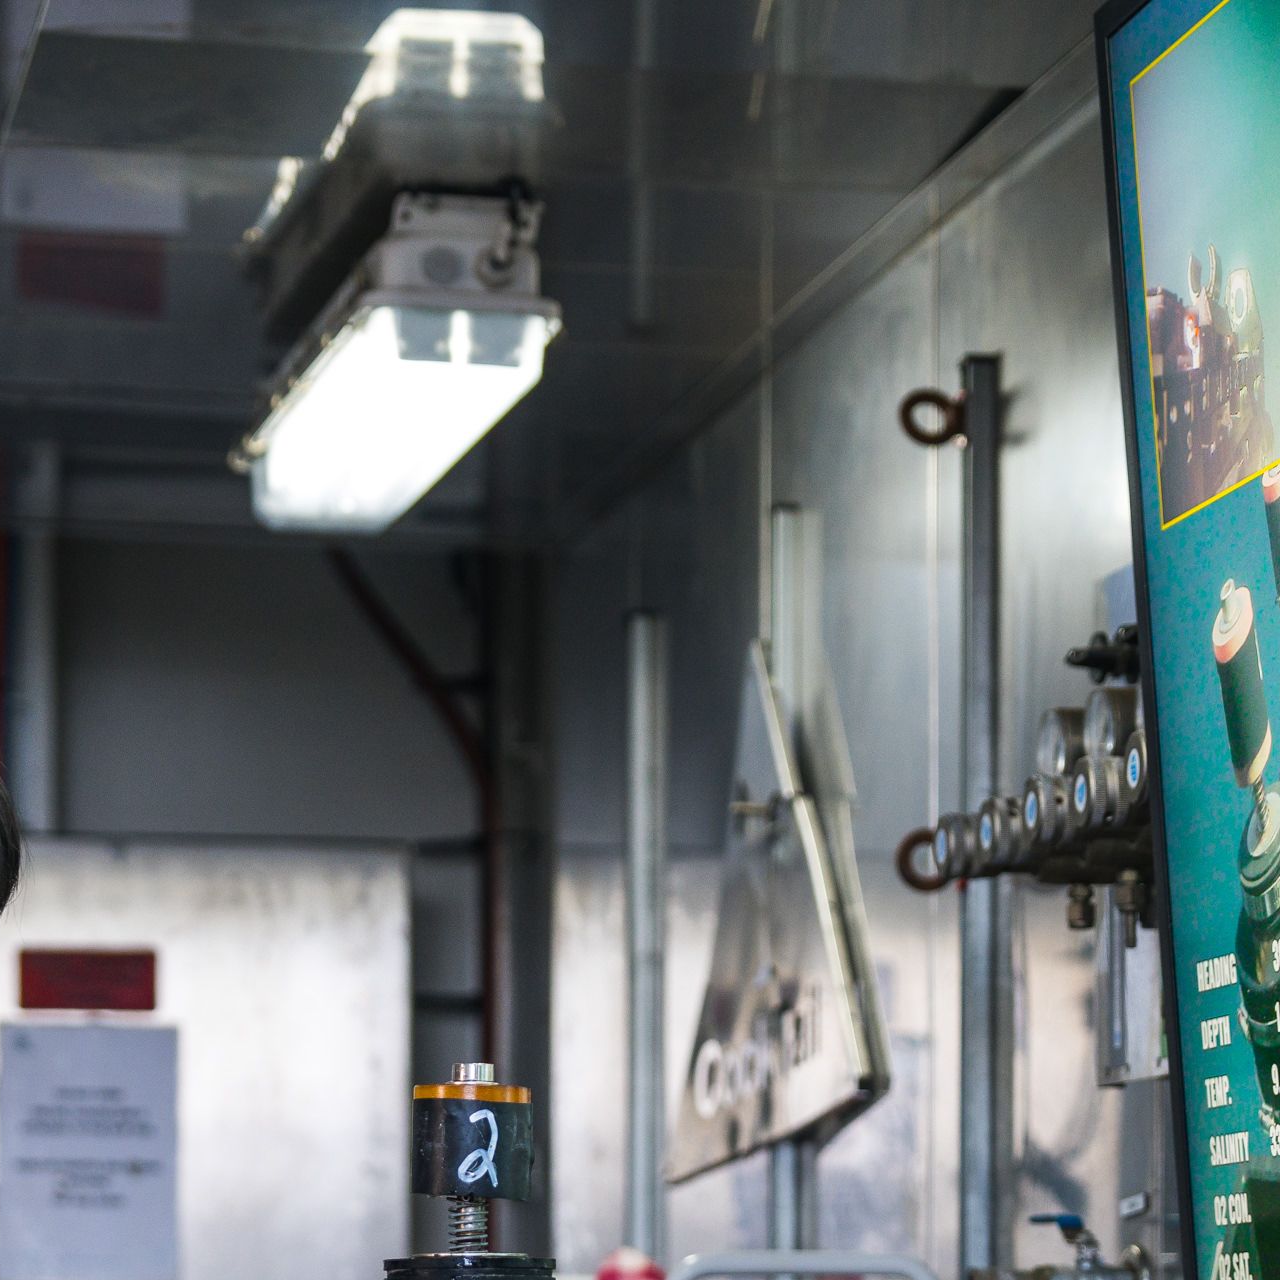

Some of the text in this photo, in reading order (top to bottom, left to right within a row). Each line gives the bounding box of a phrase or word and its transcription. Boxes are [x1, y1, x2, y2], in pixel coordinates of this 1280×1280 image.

[1196, 953, 1237, 992] HEADING
[1201, 1016, 1231, 1050] DEPTH
[1205, 1075, 1233, 1108] TEMP.
[457, 1108, 499, 1188] 2
[1209, 1131, 1250, 1166] SALINITY
[1228, 1192, 1252, 1225] CON.
